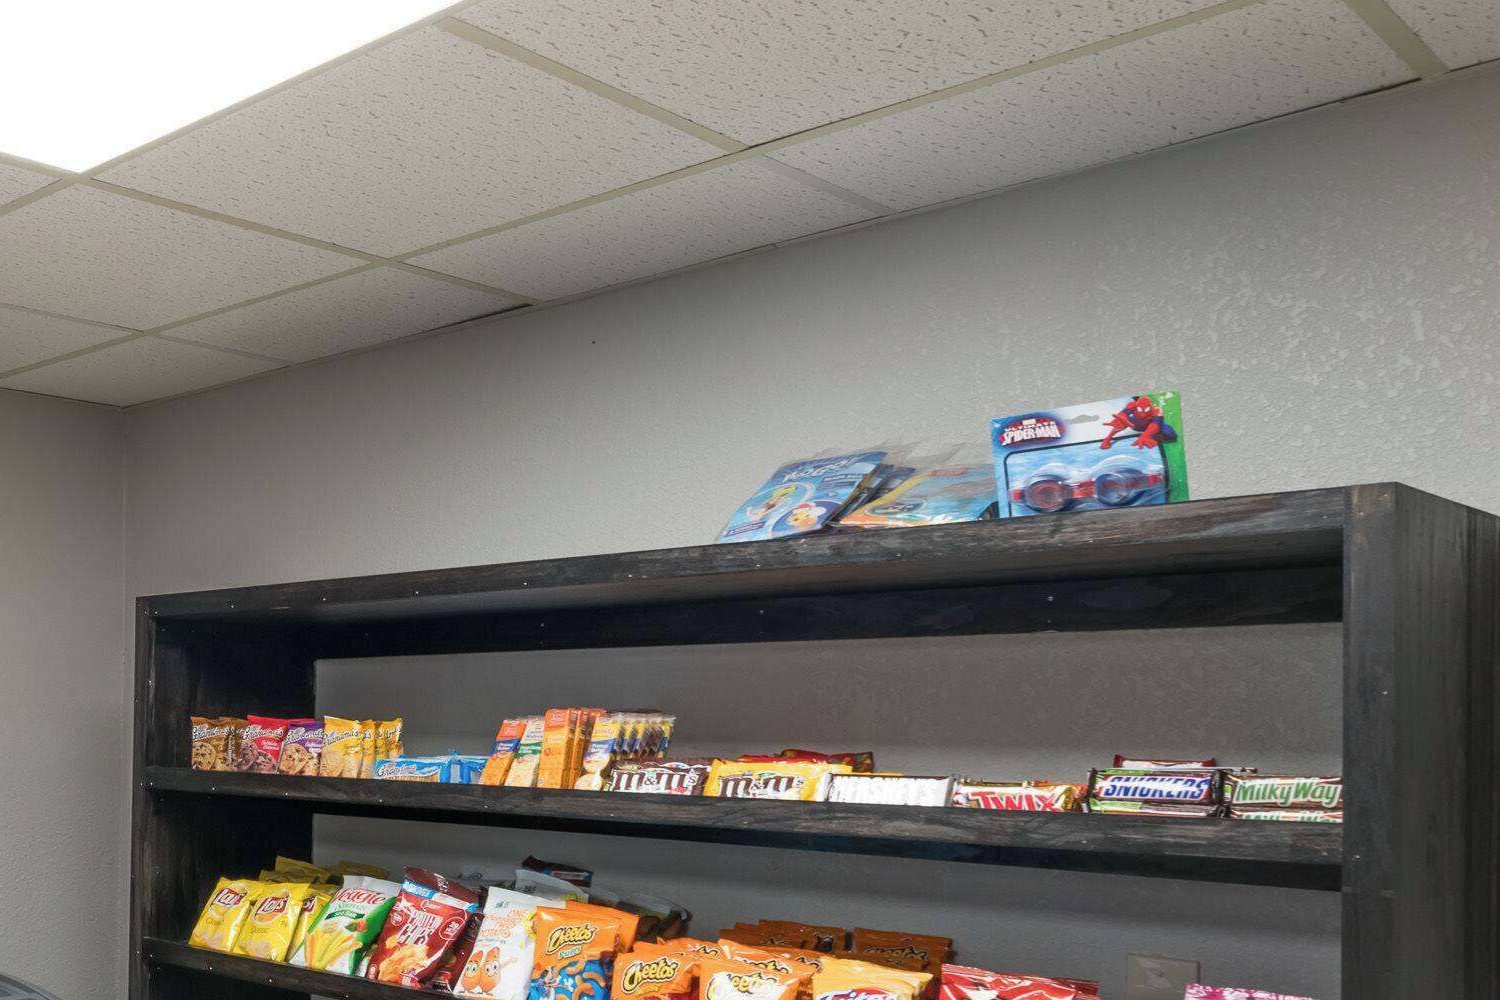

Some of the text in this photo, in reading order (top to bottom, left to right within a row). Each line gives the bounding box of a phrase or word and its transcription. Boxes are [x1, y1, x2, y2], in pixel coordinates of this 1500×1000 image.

[1002, 424, 1061, 445] SPIDER-MAN
[970, 791, 1062, 811] TWIX
[1233, 780, 1293, 806] Milky
[546, 923, 597, 955] Cheetos
[622, 957, 679, 993] Cheetos
